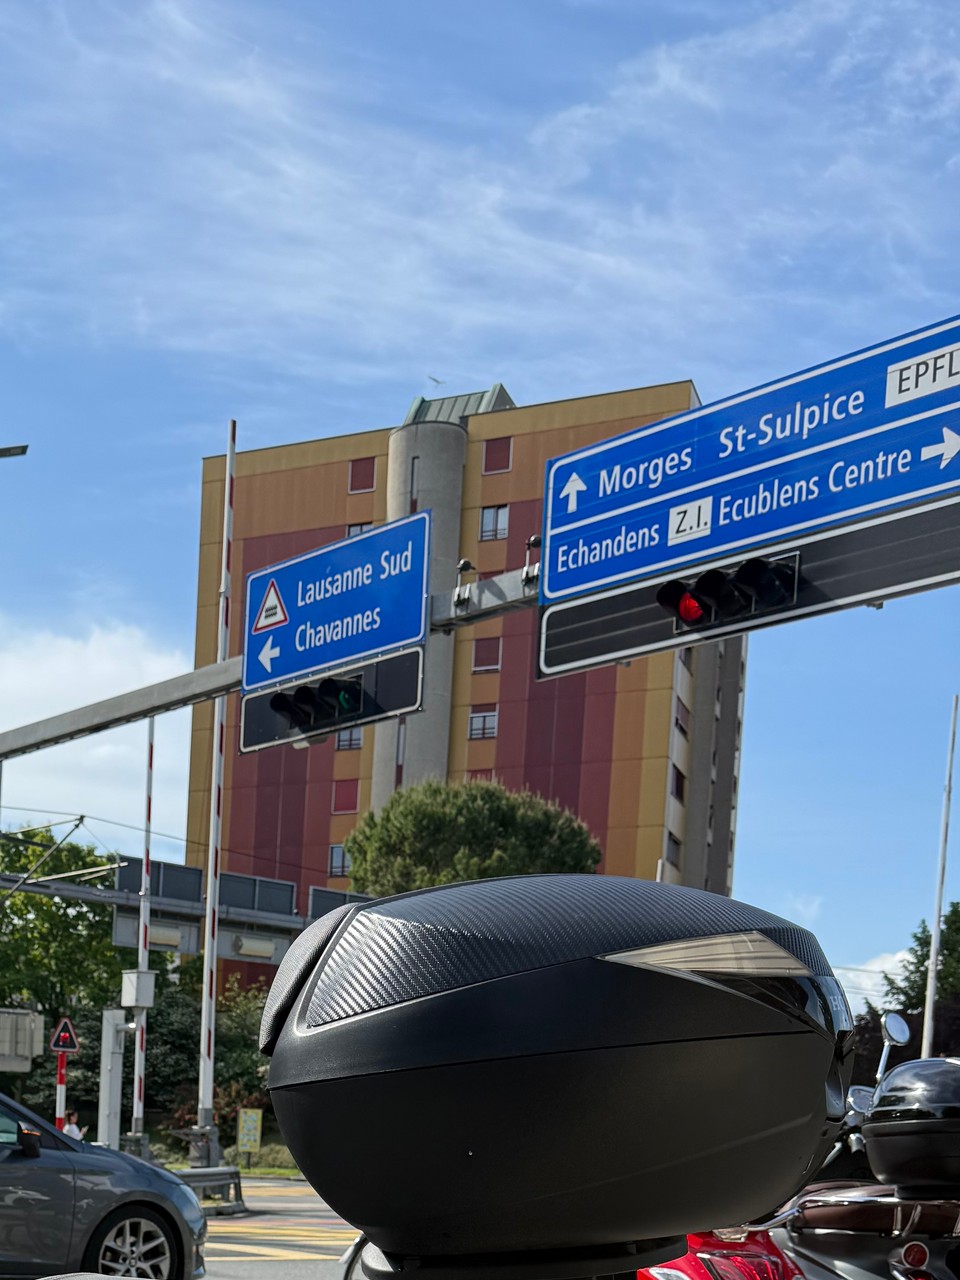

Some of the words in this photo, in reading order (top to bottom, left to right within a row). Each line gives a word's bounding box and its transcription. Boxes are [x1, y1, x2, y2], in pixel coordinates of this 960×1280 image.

[598, 448, 692, 498] Morges
[719, 390, 865, 458] St-Sulpice
[898, 350, 960, 394] EPFL
[557, 524, 660, 573] Echandens
[675, 505, 708, 535] Z.I.
[719, 476, 820, 526] Ecublens
[828, 448, 912, 493] Centre
[297, 562, 373, 607] Lausanne
[380, 541, 412, 579] Sud
[295, 607, 381, 652] Chavannes
